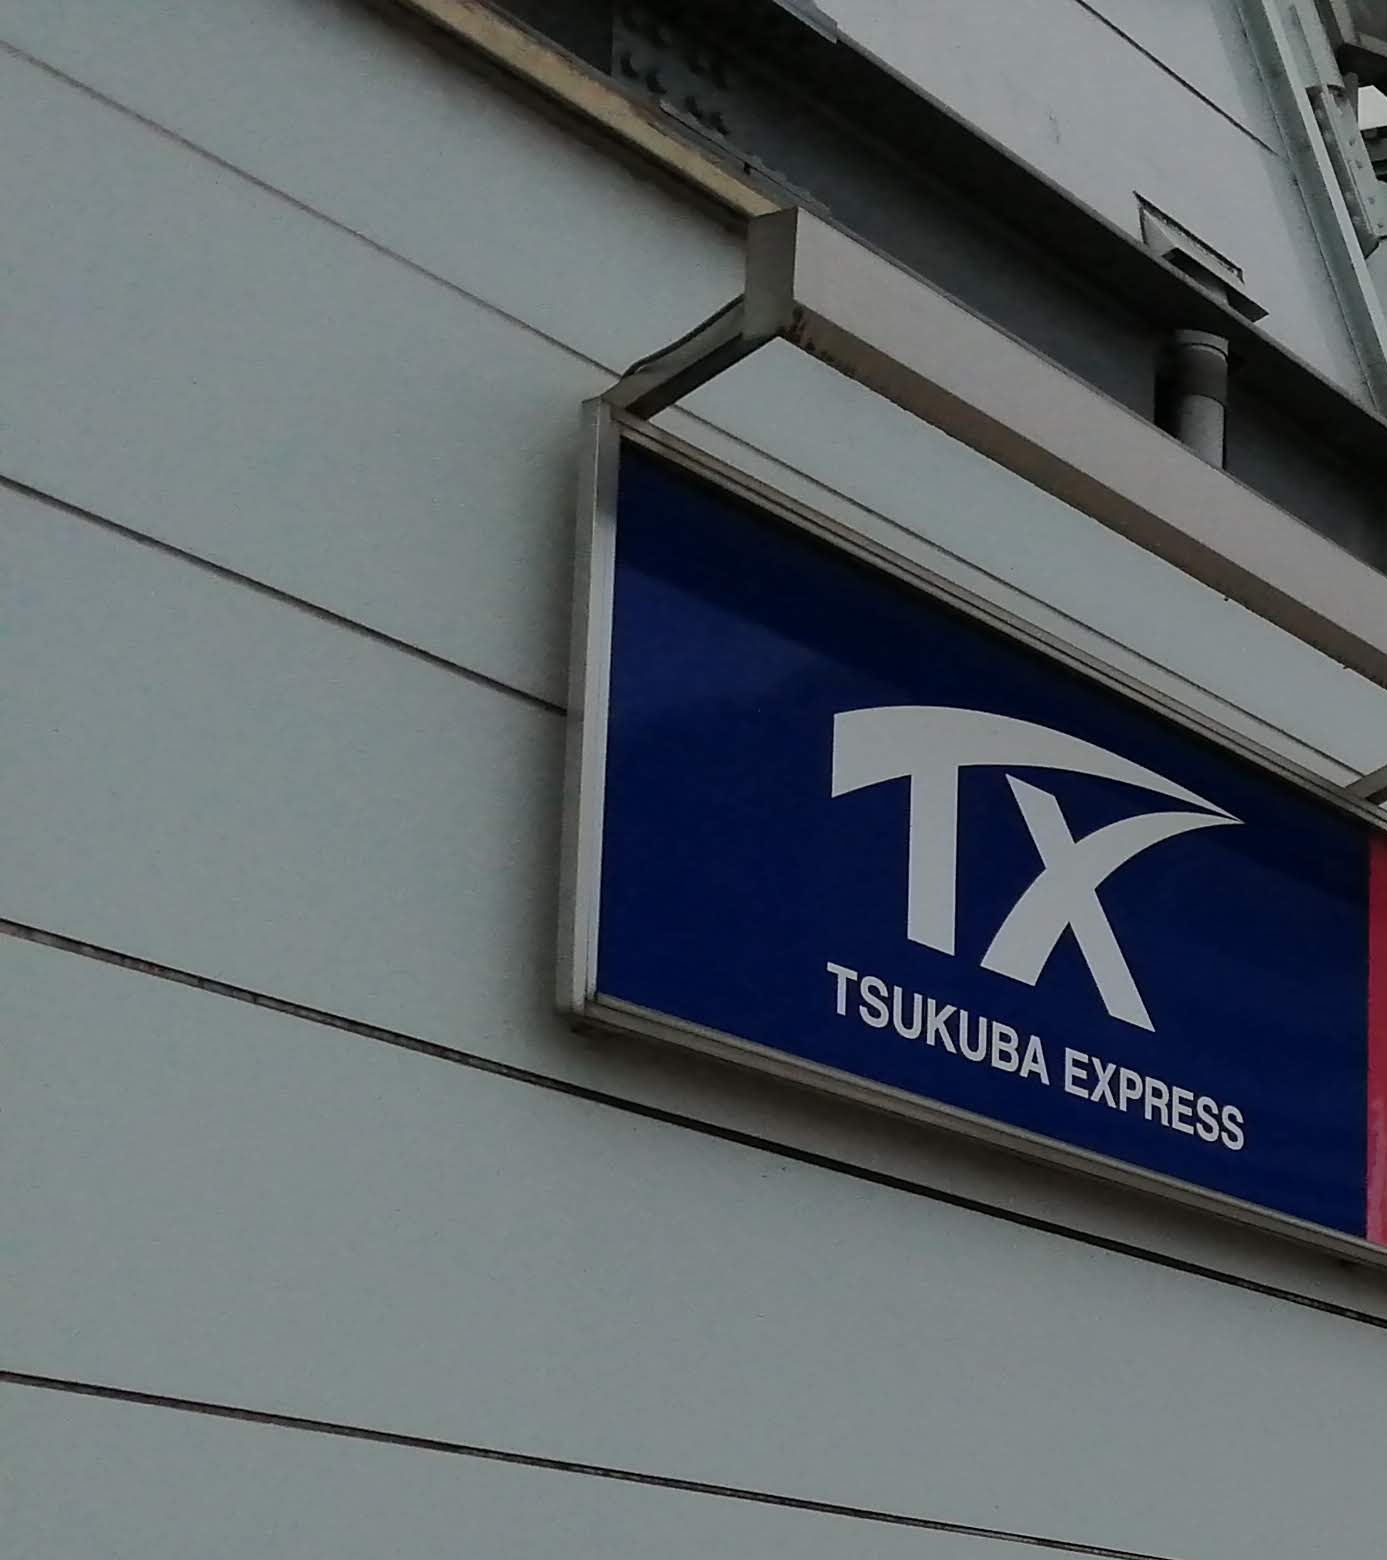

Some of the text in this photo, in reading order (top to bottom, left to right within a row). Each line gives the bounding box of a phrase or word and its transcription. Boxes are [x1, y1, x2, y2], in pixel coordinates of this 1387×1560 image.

[831, 705, 1244, 1033] TX
[826, 961, 1245, 1151] TSUKUBA EXPRESS
